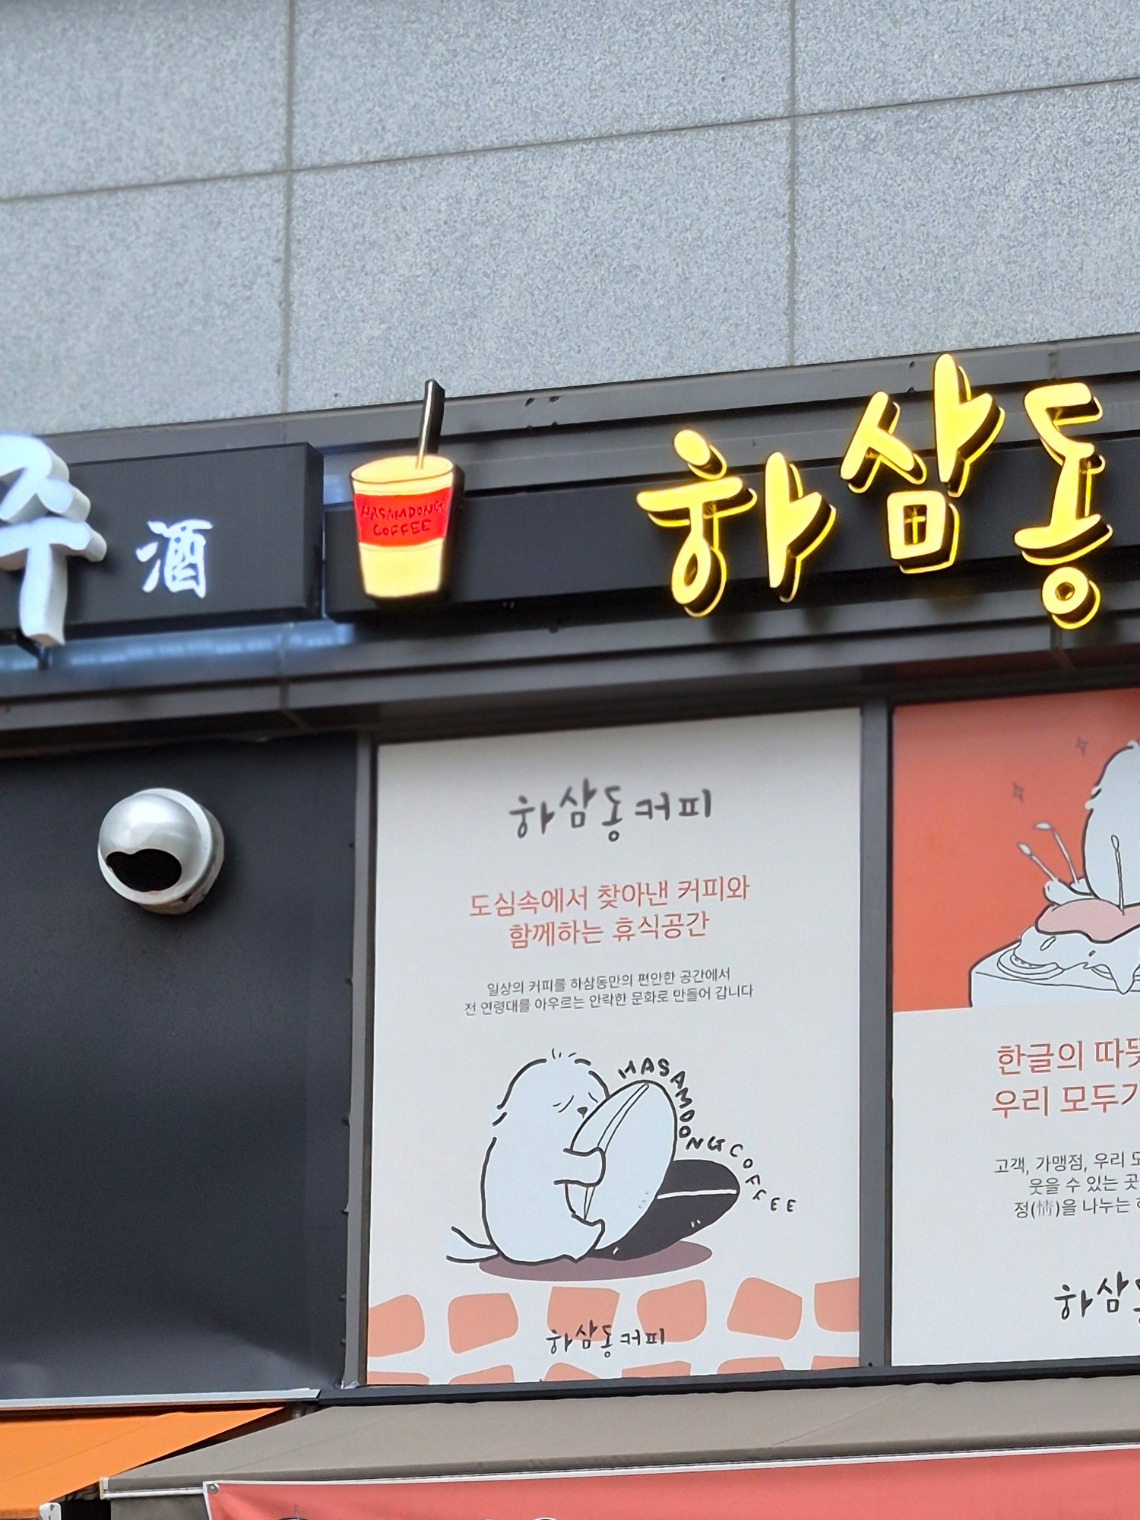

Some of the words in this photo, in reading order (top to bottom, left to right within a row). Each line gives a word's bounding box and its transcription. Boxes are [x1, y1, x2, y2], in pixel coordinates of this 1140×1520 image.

[360, 501, 443, 520] HASAMDONG
[373, 519, 432, 536] COFFEE
[468, 886, 589, 918] 도심속에서
[596, 880, 669, 910] 찾아낸
[676, 874, 751, 902] 커피와
[508, 919, 604, 949] 함께하는
[612, 910, 710, 942] 휴식공간
[486, 981, 525, 997] 일상의
[528, 978, 567, 994] 커피를
[570, 974, 634, 991] 하삼동만의
[637, 971, 676, 987] 편안한
[679, 967, 731, 983] 공간에서
[464, 1002, 477, 1016] 전
[481, 998, 530, 1015] 연령대를
[534, 995, 585, 1011] 아우르는
[588, 992, 627, 1007] 안락한
[631, 990, 669, 1006] 문화로
[672, 987, 712, 1003] 만들어
[715, 984, 754, 999] 갑니다
[997, 1040, 1084, 1076] 한글의
[991, 1085, 1049, 1119] 우리
[993, 1157, 1029, 1175] 고객,
[1036, 1153, 1087, 1173] 가맹점,
[1093, 1151, 1124, 1169] 우리
[1029, 1177, 1060, 1195] 웃을
[1065, 1177, 1081, 1194] 수
[1086, 1174, 1119, 1192] 있는
[1082, 1196, 1131, 1215] 나누는
